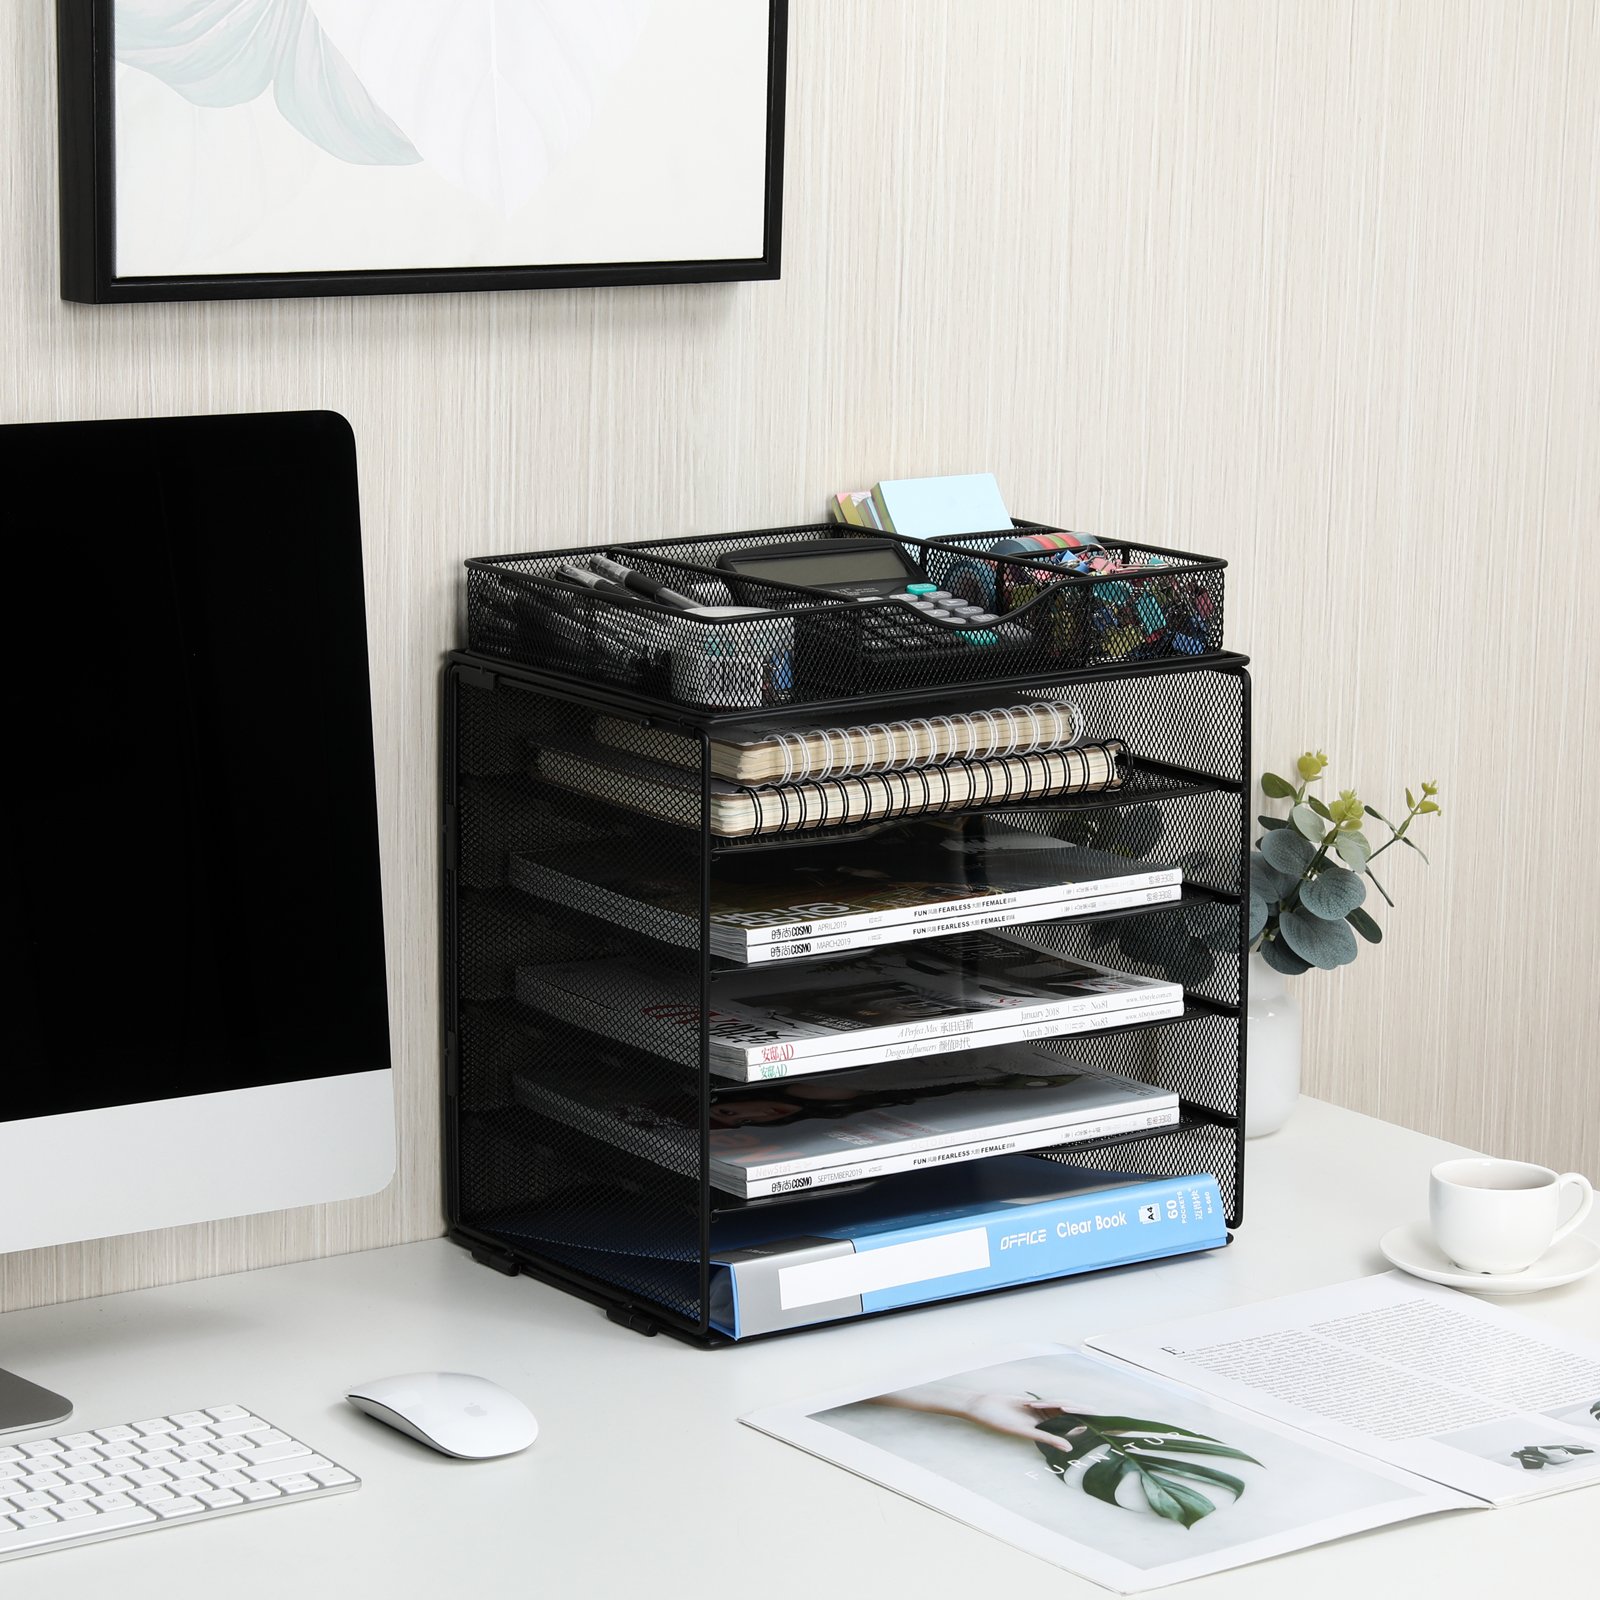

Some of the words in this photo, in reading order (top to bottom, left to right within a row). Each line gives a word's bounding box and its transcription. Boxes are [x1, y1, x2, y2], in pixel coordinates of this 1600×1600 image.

[913, 909, 928, 917] FUN
[938, 902, 971, 914] FEARLESS
[982, 897, 1007, 908] FEMALE
[912, 927, 927, 935] FUN
[937, 920, 970, 932] FEARLESS
[980, 915, 1006, 926] FEMALE
[1020, 1009, 1044, 1022] January
[1044, 1007, 1060, 1016] 2018
[904, 1025, 924, 1039] Perfect
[1022, 1028, 1043, 1039] March
[1044, 1024, 1059, 1033] 2018
[884, 1046, 906, 1059] Design
[906, 1042, 937, 1057] Influencers
[913, 1157, 927, 1166] FUN
[937, 1149, 970, 1161] FEARLESS
[980, 1143, 1006, 1154] FEMALE
[1147, 1206, 1155, 1220] A4
[1166, 1199, 1179, 1219] 60
[1176, 1191, 1188, 1224] POCKETS
[1056, 1219, 1092, 1238] Clear
[1095, 1210, 1127, 1230] Book
[1000, 1228, 1047, 1251] OFFICE
